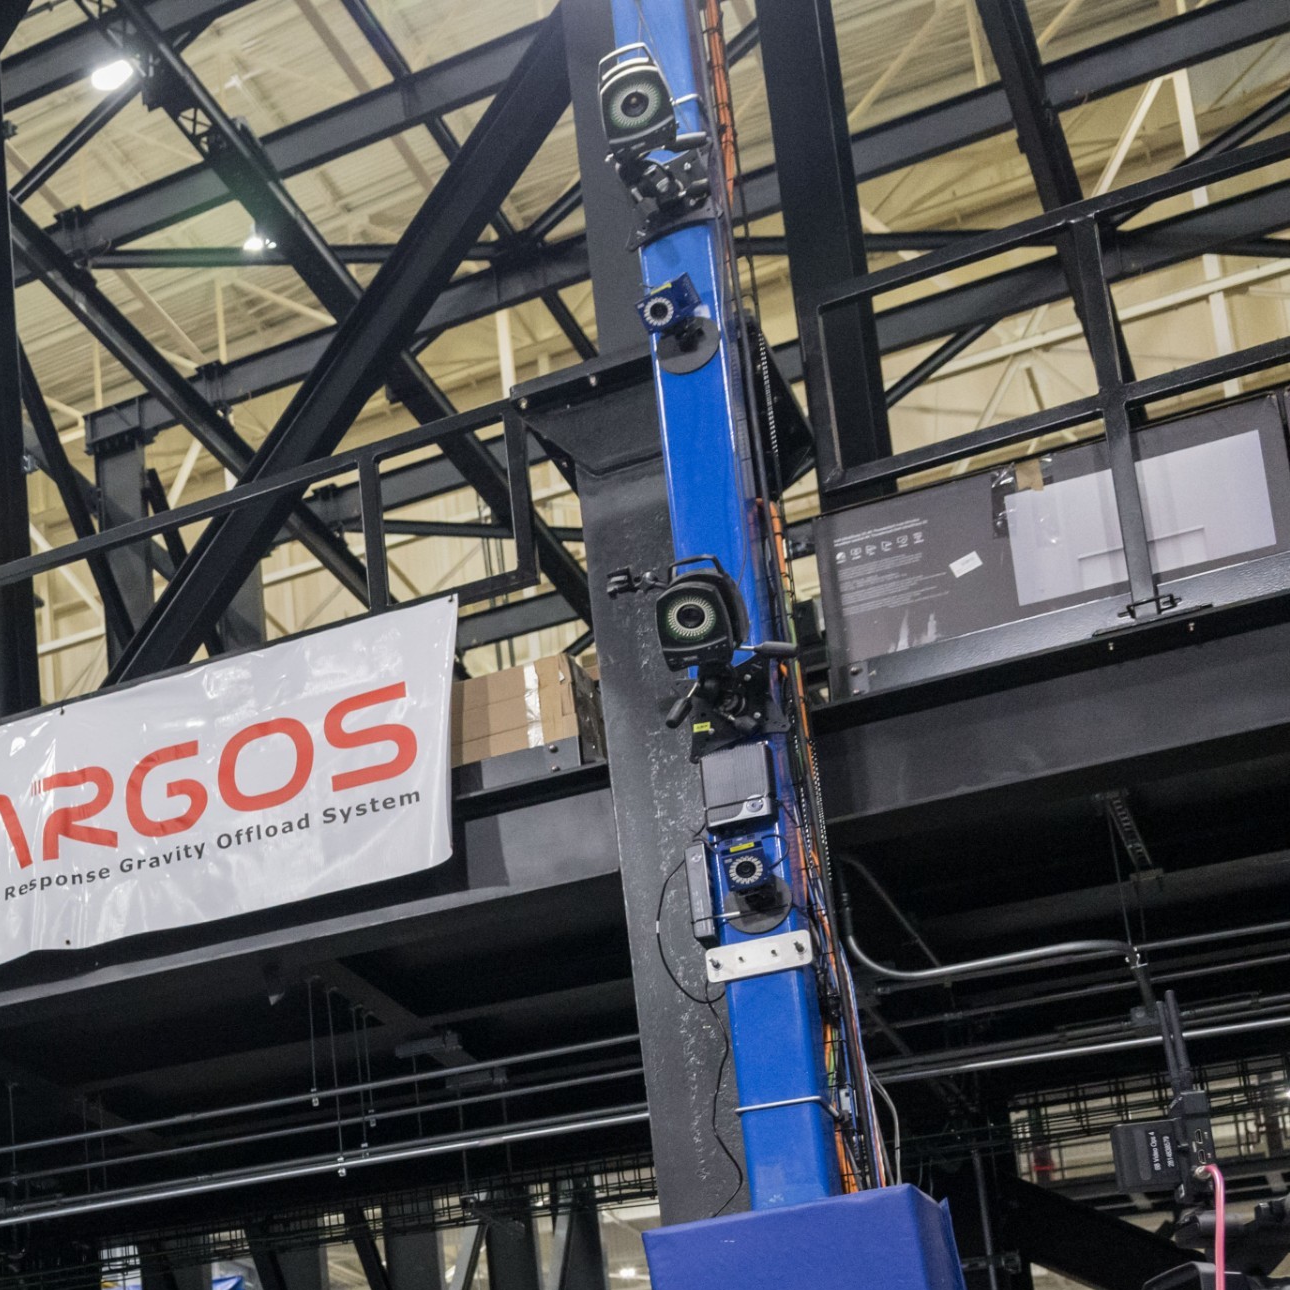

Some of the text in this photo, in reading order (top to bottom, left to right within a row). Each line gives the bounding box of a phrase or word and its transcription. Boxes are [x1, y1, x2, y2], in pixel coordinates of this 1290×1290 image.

[4, 866, 111, 901] Response
[119, 841, 207, 875] Gravity
[216, 812, 312, 851] Offload
[322, 790, 422, 826] System
